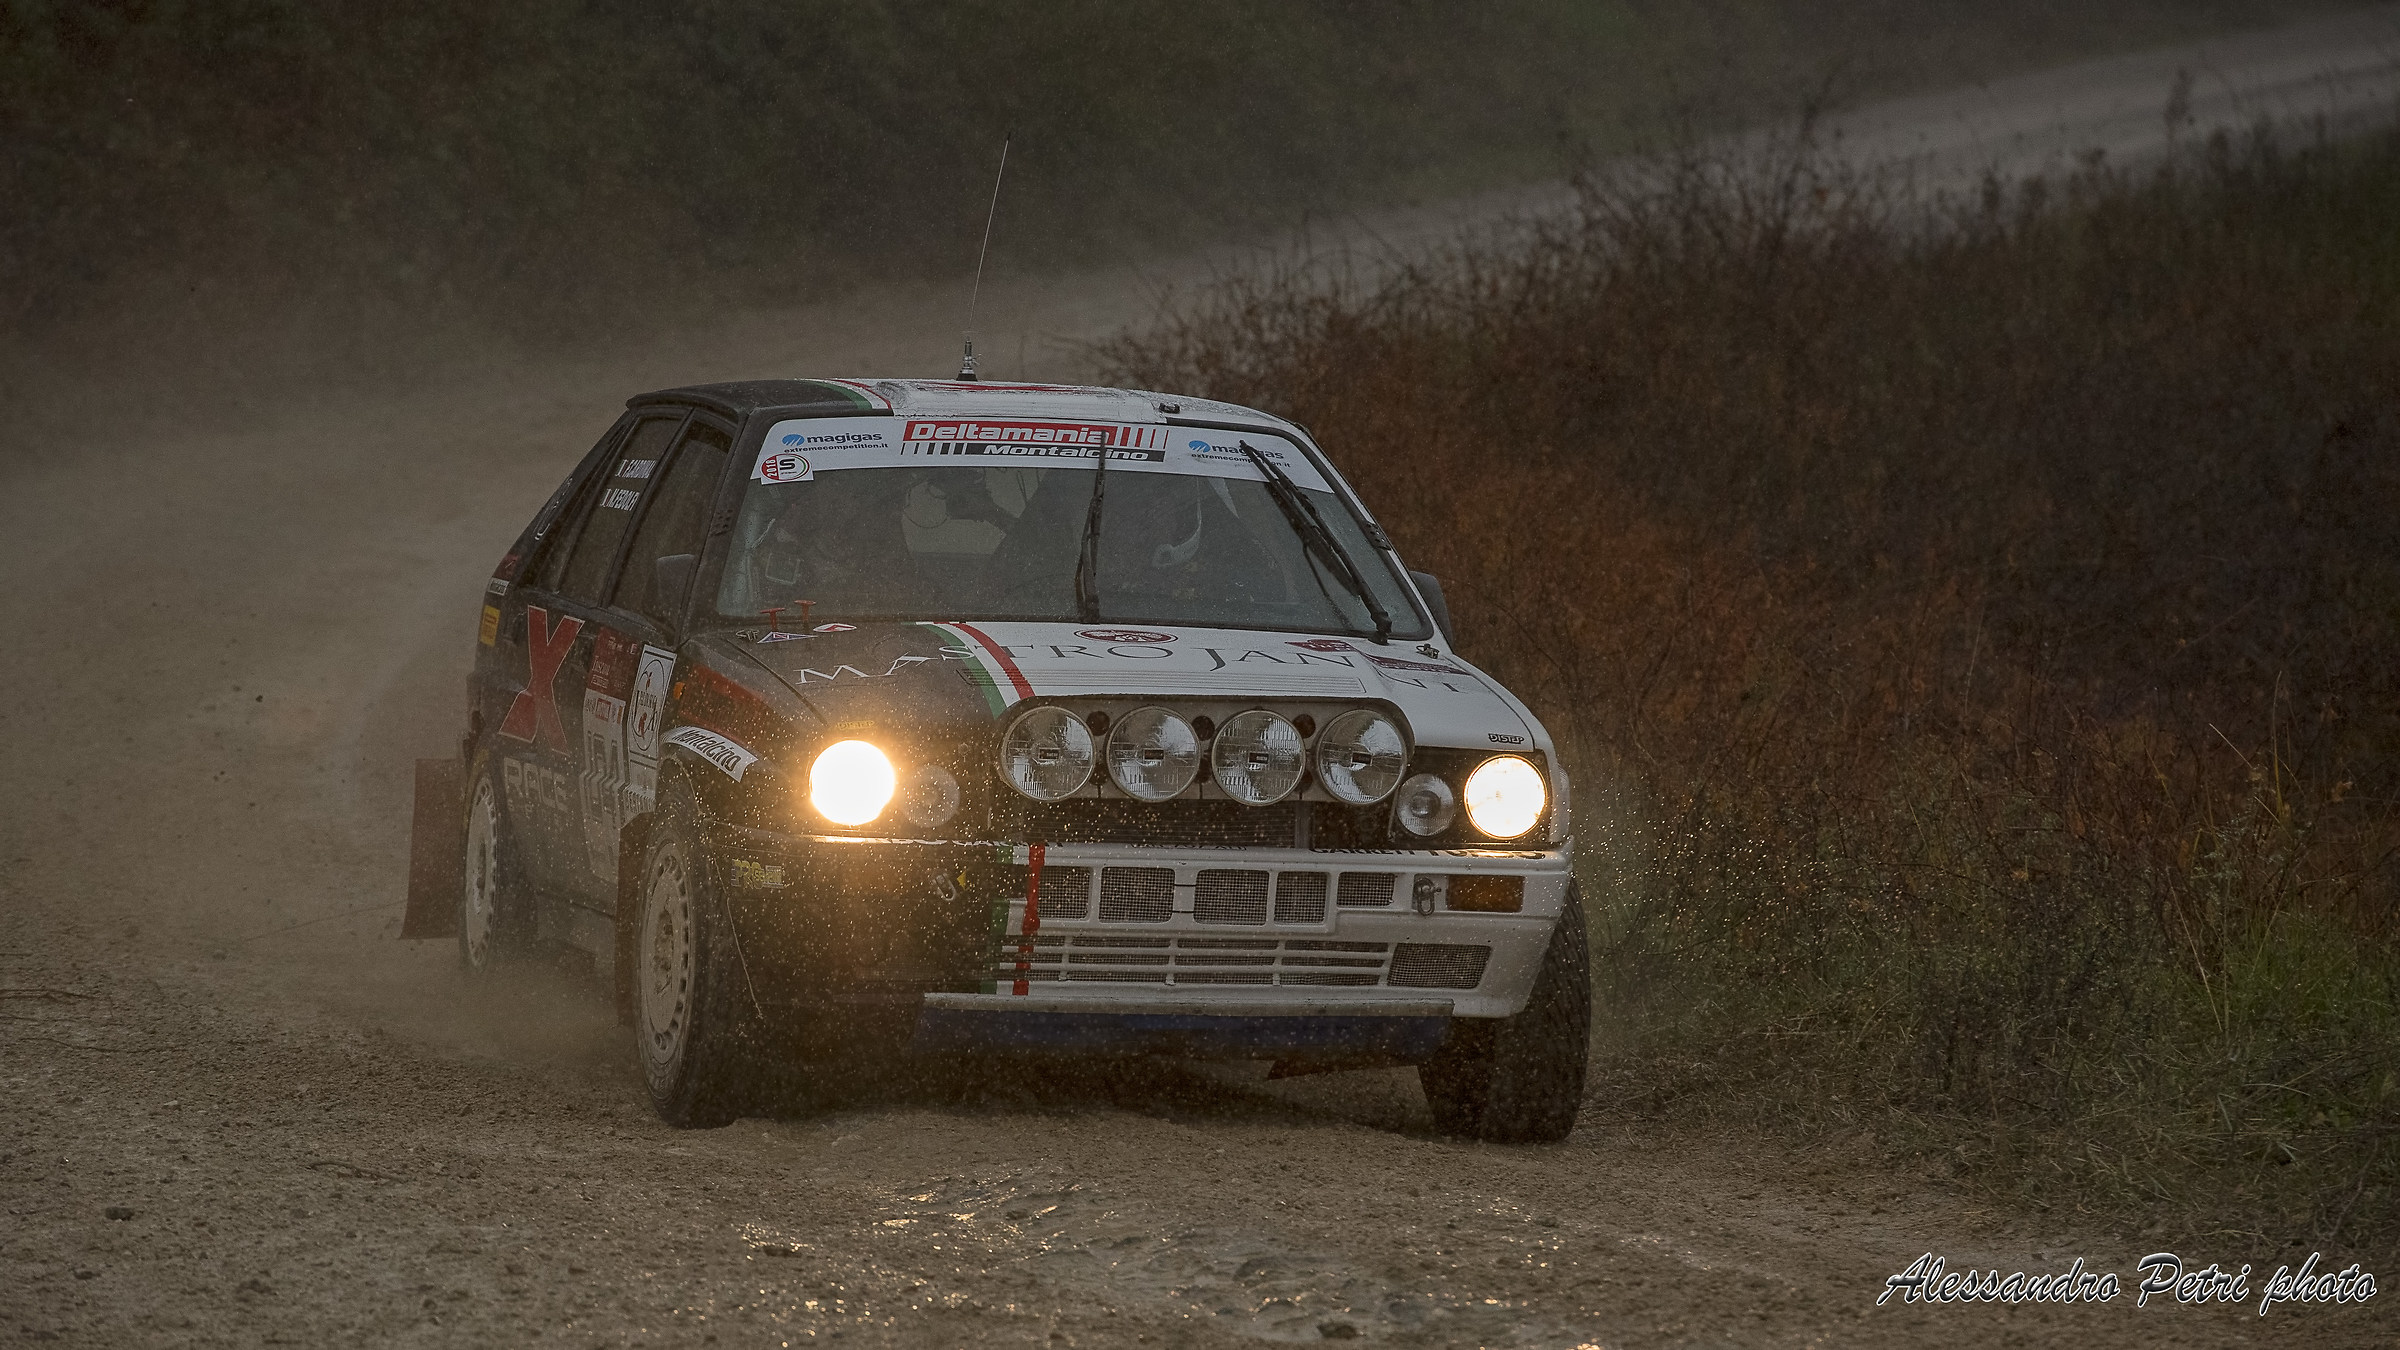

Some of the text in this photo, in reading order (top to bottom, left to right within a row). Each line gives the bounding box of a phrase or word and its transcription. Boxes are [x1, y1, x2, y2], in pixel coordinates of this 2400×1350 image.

[806, 432, 883, 447] magigas
[911, 422, 1110, 445] Deltamania
[784, 443, 889, 453] extremecompetition.it
[983, 444, 1149, 461] Montalcino
[765, 459, 777, 477] 2018
[779, 458, 796, 471] S
[793, 644, 1174, 685] MASTRO
[1190, 647, 1468, 694] JANNI
[498, 604, 586, 758] X
[503, 757, 569, 814] RACE
